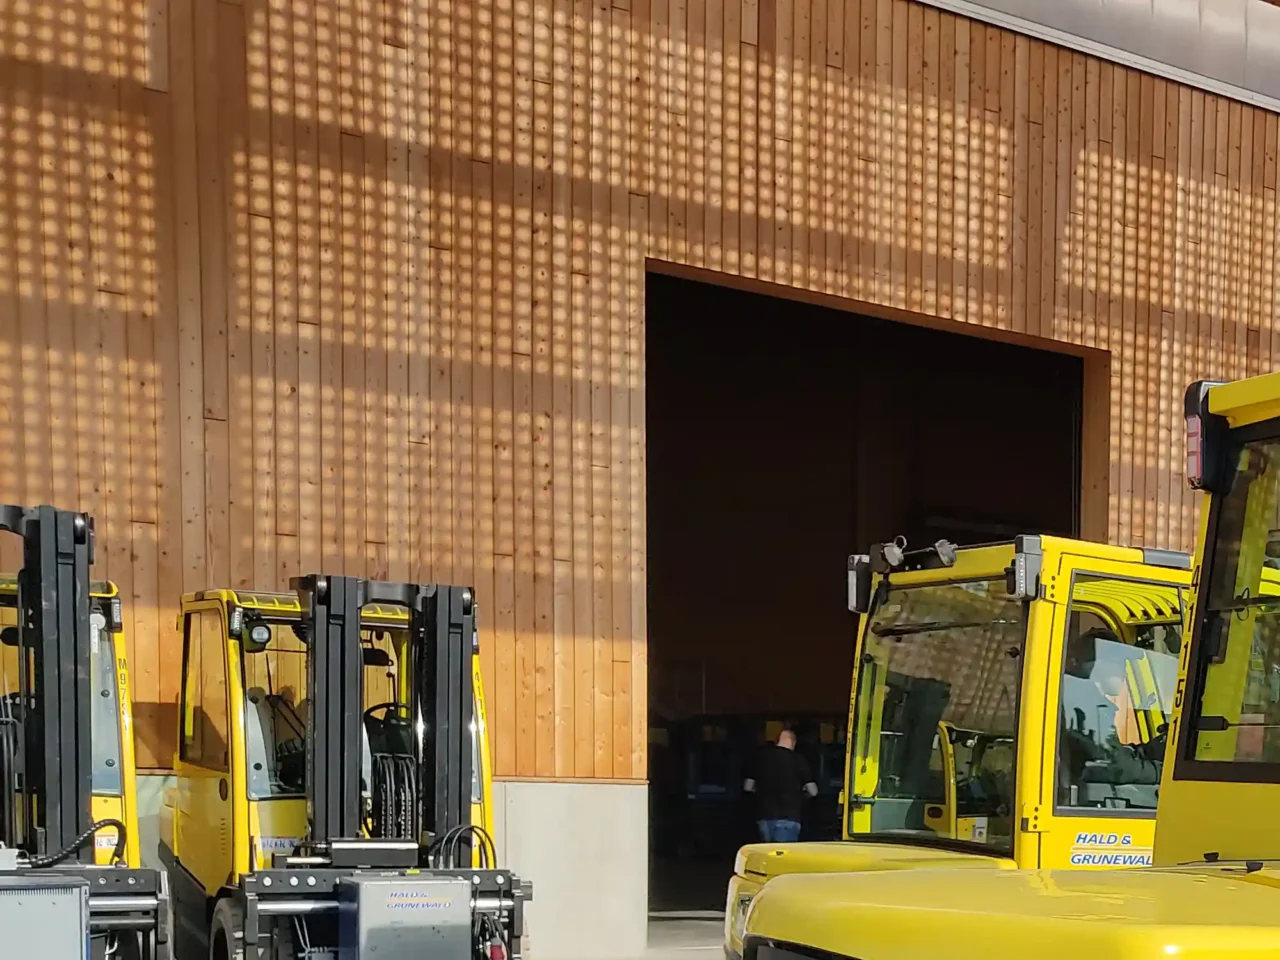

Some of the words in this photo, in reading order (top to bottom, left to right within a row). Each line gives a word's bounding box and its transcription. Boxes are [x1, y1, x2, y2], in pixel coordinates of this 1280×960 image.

[1172, 565, 1200, 746] 41151
[1076, 834, 1117, 845] HALD
[1121, 835, 1132, 845] &
[1070, 853, 1153, 866] GRUNEWAL
